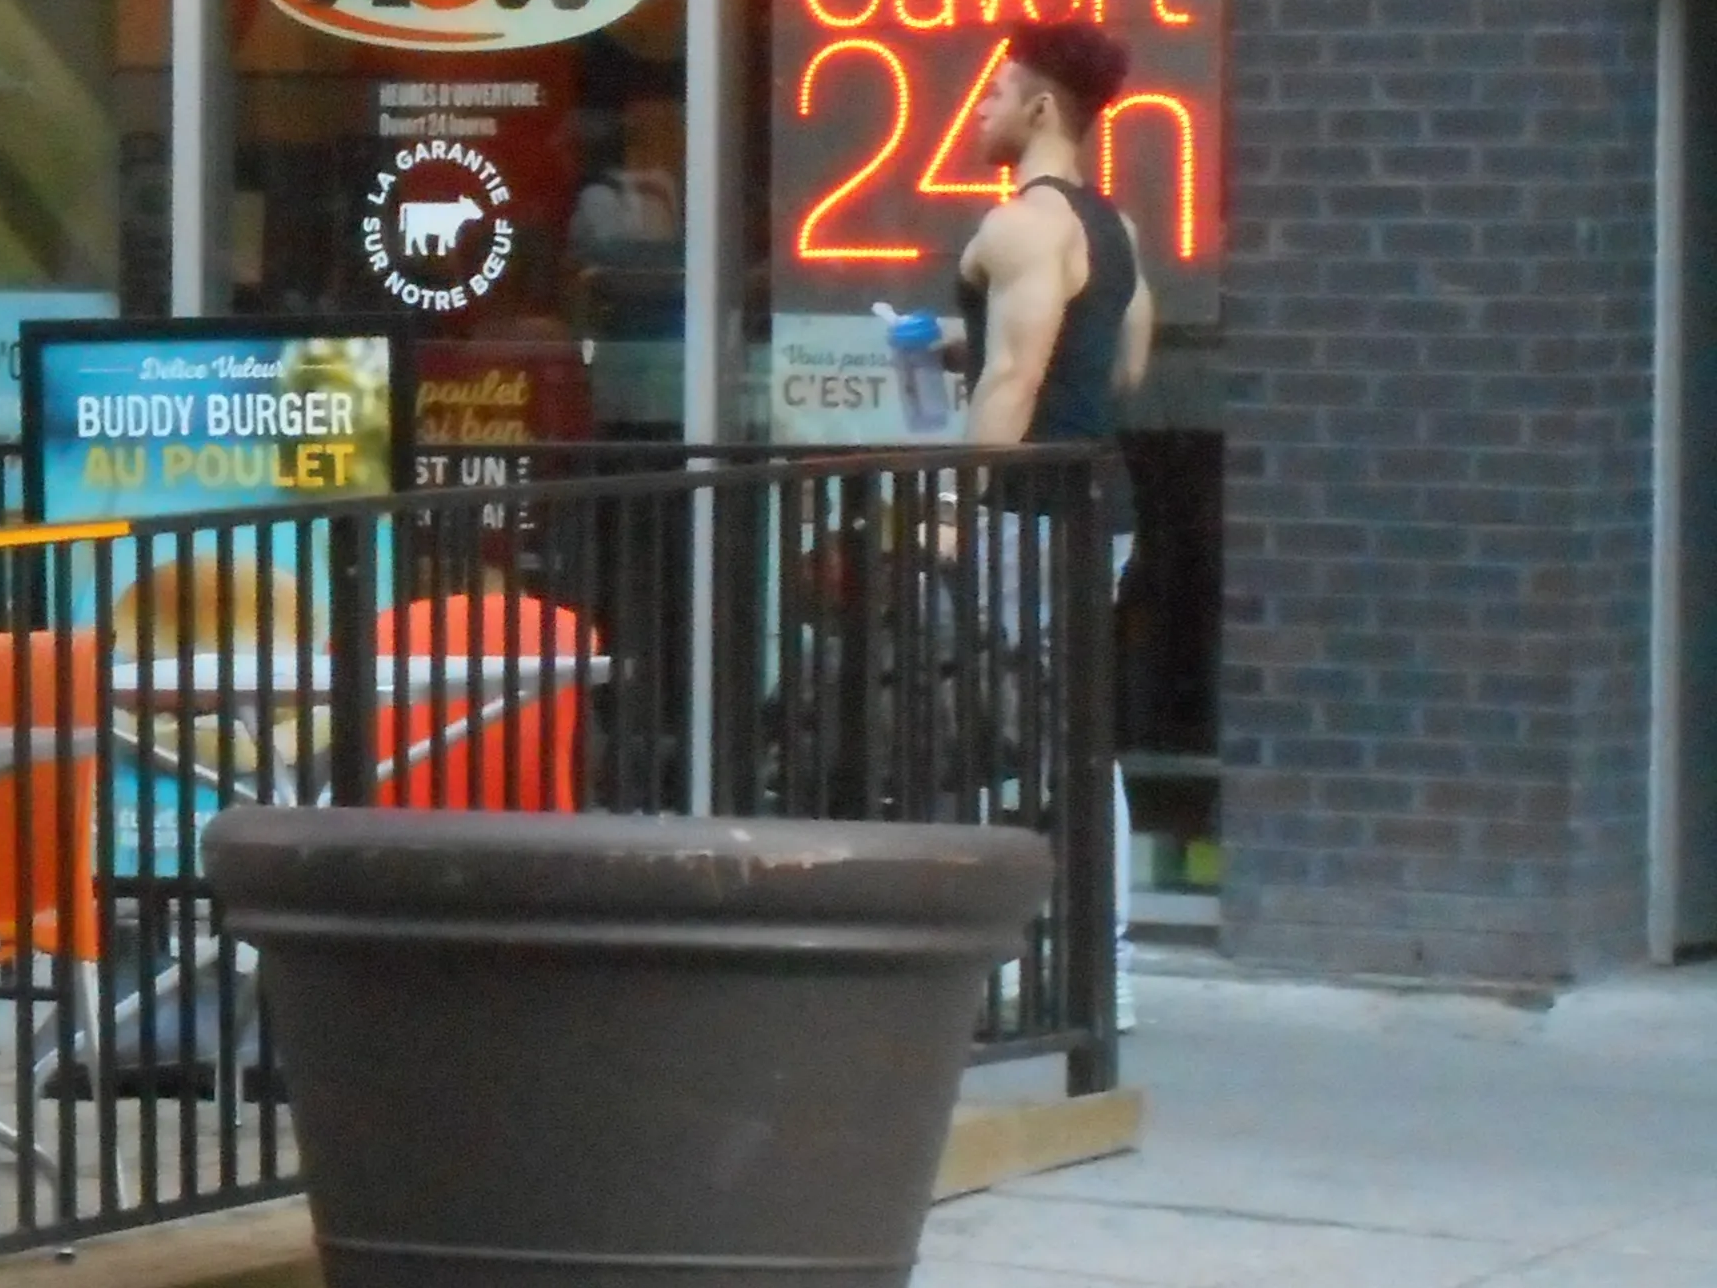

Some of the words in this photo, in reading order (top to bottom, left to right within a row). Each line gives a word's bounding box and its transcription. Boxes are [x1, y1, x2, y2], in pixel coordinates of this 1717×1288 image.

[367, 171, 396, 205] LA
[395, 140, 511, 206] GARANTIE
[363, 216, 390, 272] SUR
[384, 271, 468, 311] NOTRE
[77, 394, 195, 438] BUDDY
[206, 391, 355, 437] BURGER
[416, 369, 532, 417] poulet
[782, 373, 886, 411] C'EST
[83, 444, 146, 490] AU
[161, 442, 356, 489] POULET
[461, 455, 507, 487] UN
